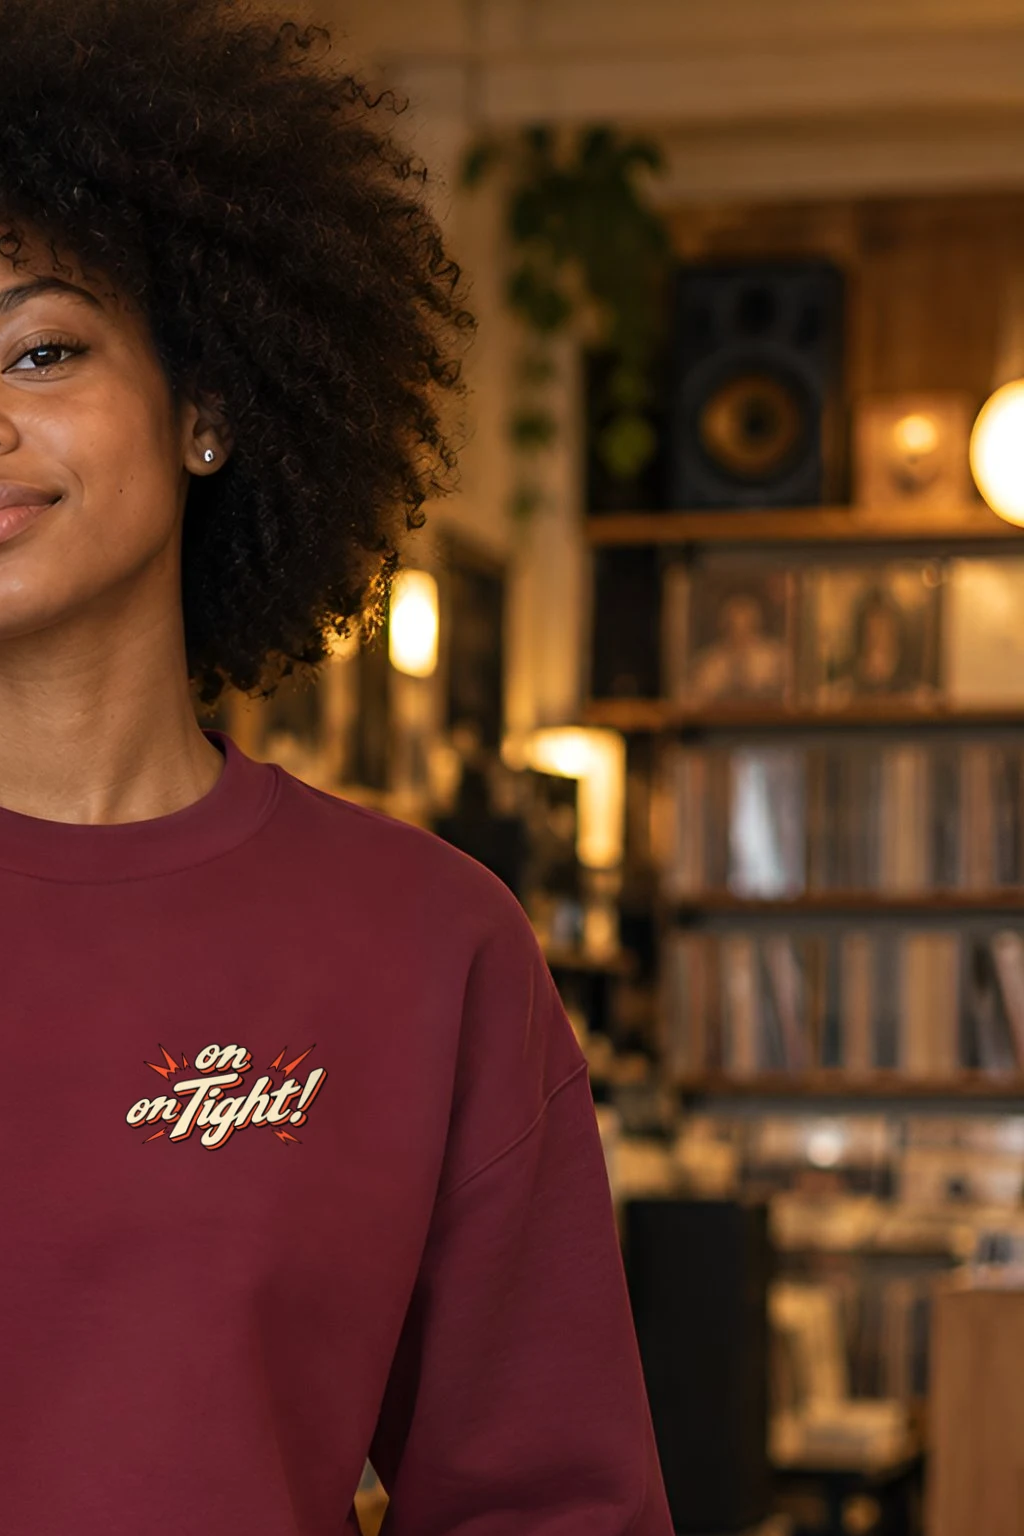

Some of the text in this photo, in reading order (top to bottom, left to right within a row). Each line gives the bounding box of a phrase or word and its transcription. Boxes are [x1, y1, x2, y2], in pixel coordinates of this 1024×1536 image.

[194, 1043, 254, 1074] on
[125, 1067, 327, 1150] on Tight!
